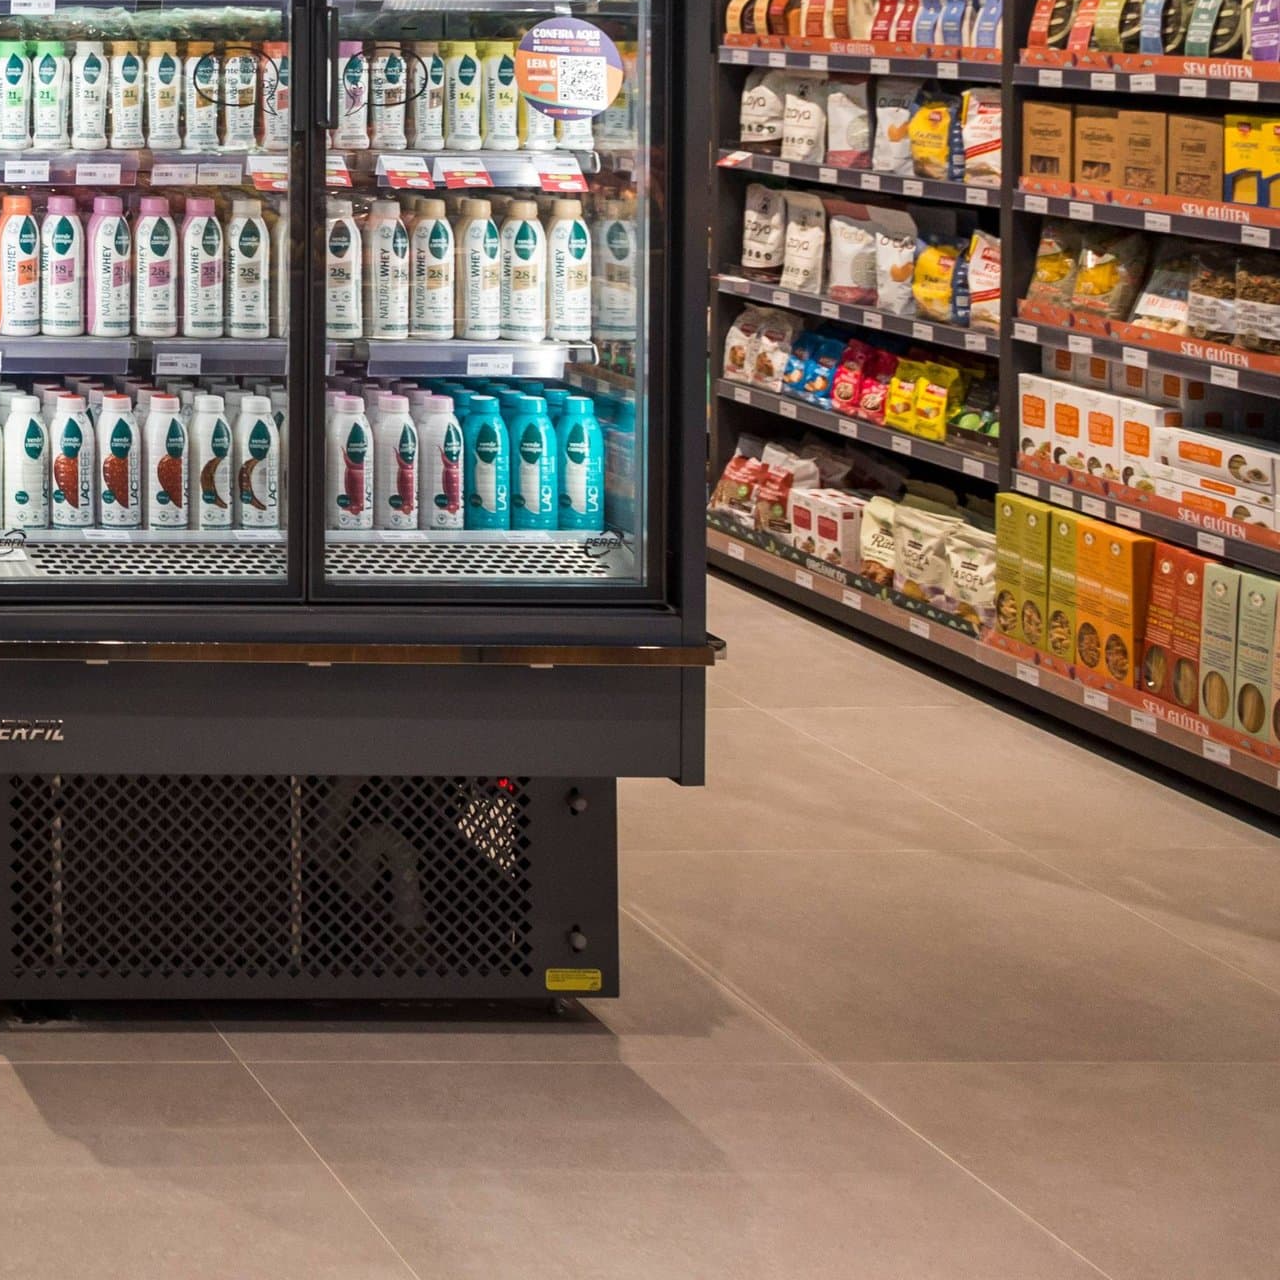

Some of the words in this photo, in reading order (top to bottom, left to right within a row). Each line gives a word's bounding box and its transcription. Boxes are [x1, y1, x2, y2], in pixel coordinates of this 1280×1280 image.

[533, 28, 574, 38] CONFIRA
[527, 59, 547, 68] LEIA
[1183, 62, 1205, 76] SEM
[1209, 61, 1253, 78] GLÚTEN
[1182, 203, 1203, 217] SEM
[1206, 204, 1250, 223] GLÚTEN
[1180, 342, 1201, 357] SEM
[1205, 343, 1249, 367] GLÚTEN
[1178, 507, 1200, 523] SEM
[1203, 511, 1246, 541] GLÚTEN
[1143, 699, 1164, 715] SEM
[1168, 706, 1210, 737] GLÚTEN
